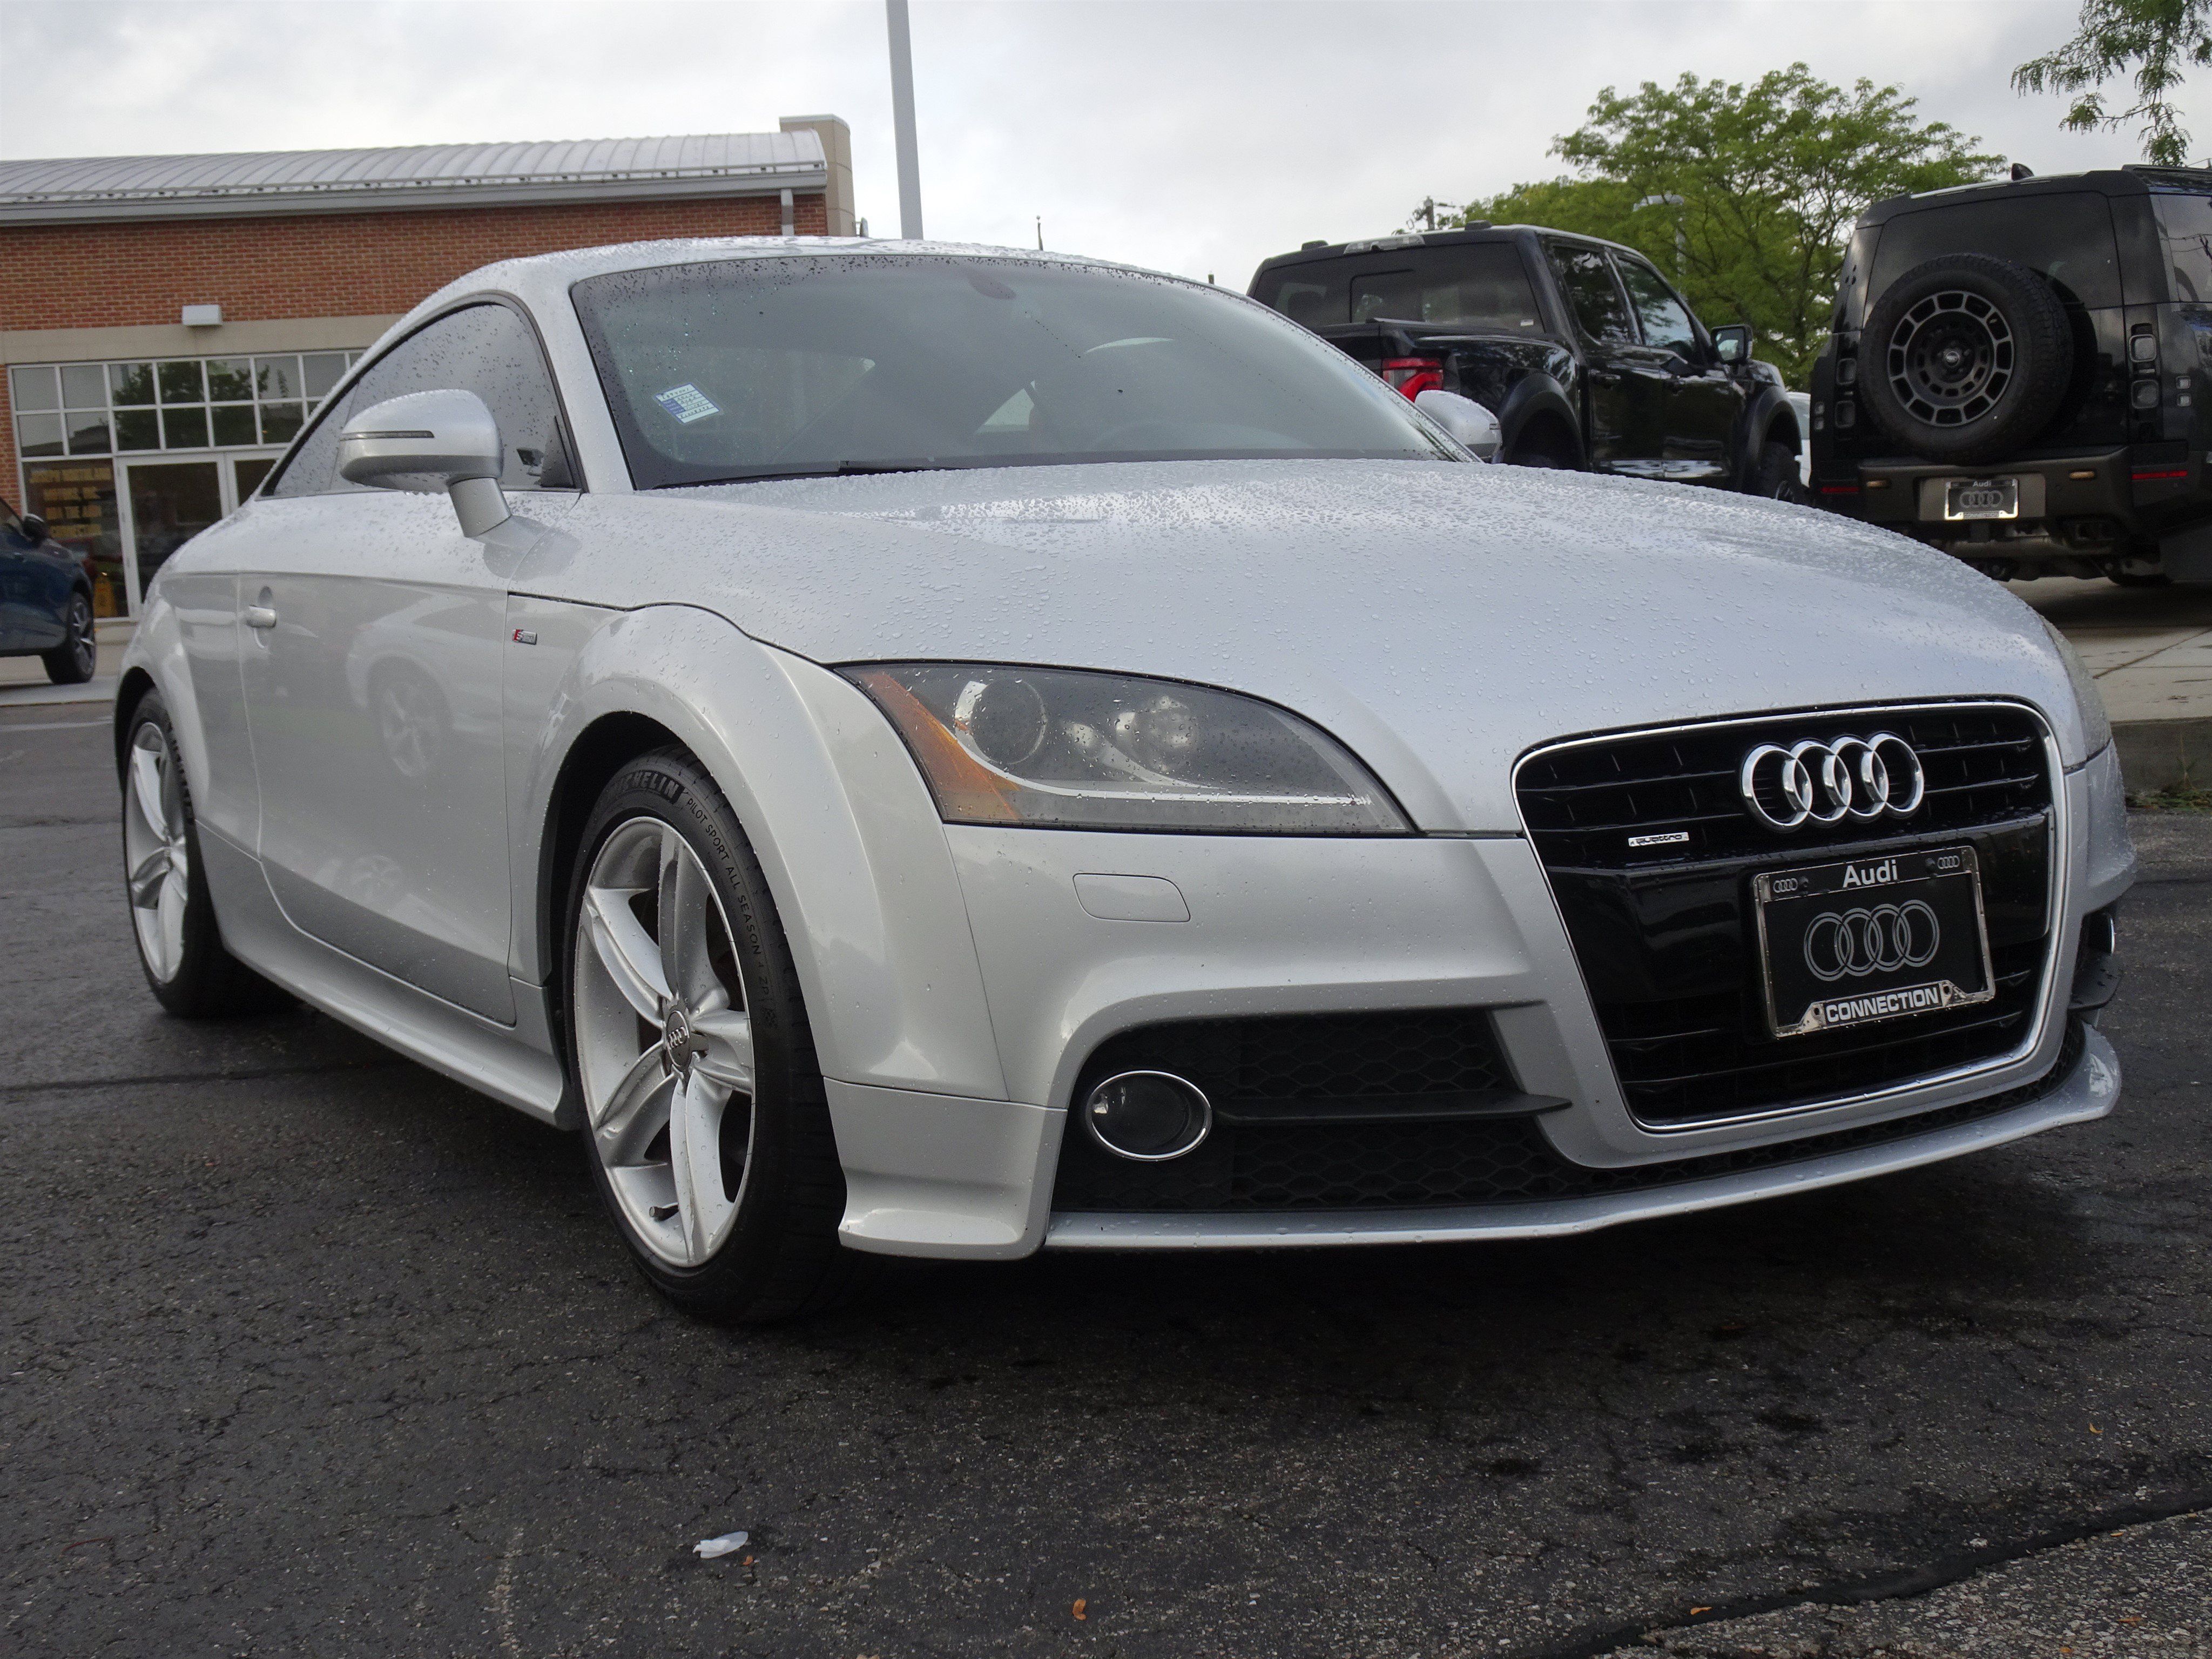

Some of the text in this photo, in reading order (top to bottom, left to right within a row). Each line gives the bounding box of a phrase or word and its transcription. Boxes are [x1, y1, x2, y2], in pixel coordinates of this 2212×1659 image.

[609, 772, 680, 800] CHELIN
[1636, 834, 1682, 846] quattro
[686, 798, 707, 824] PILOT
[705, 824, 730, 860] SPORT
[725, 866, 740, 890] ALL
[738, 894, 761, 955] SEASON
[1842, 859, 1898, 888] Audi
[1825, 987, 1939, 1023] CONNECTION
